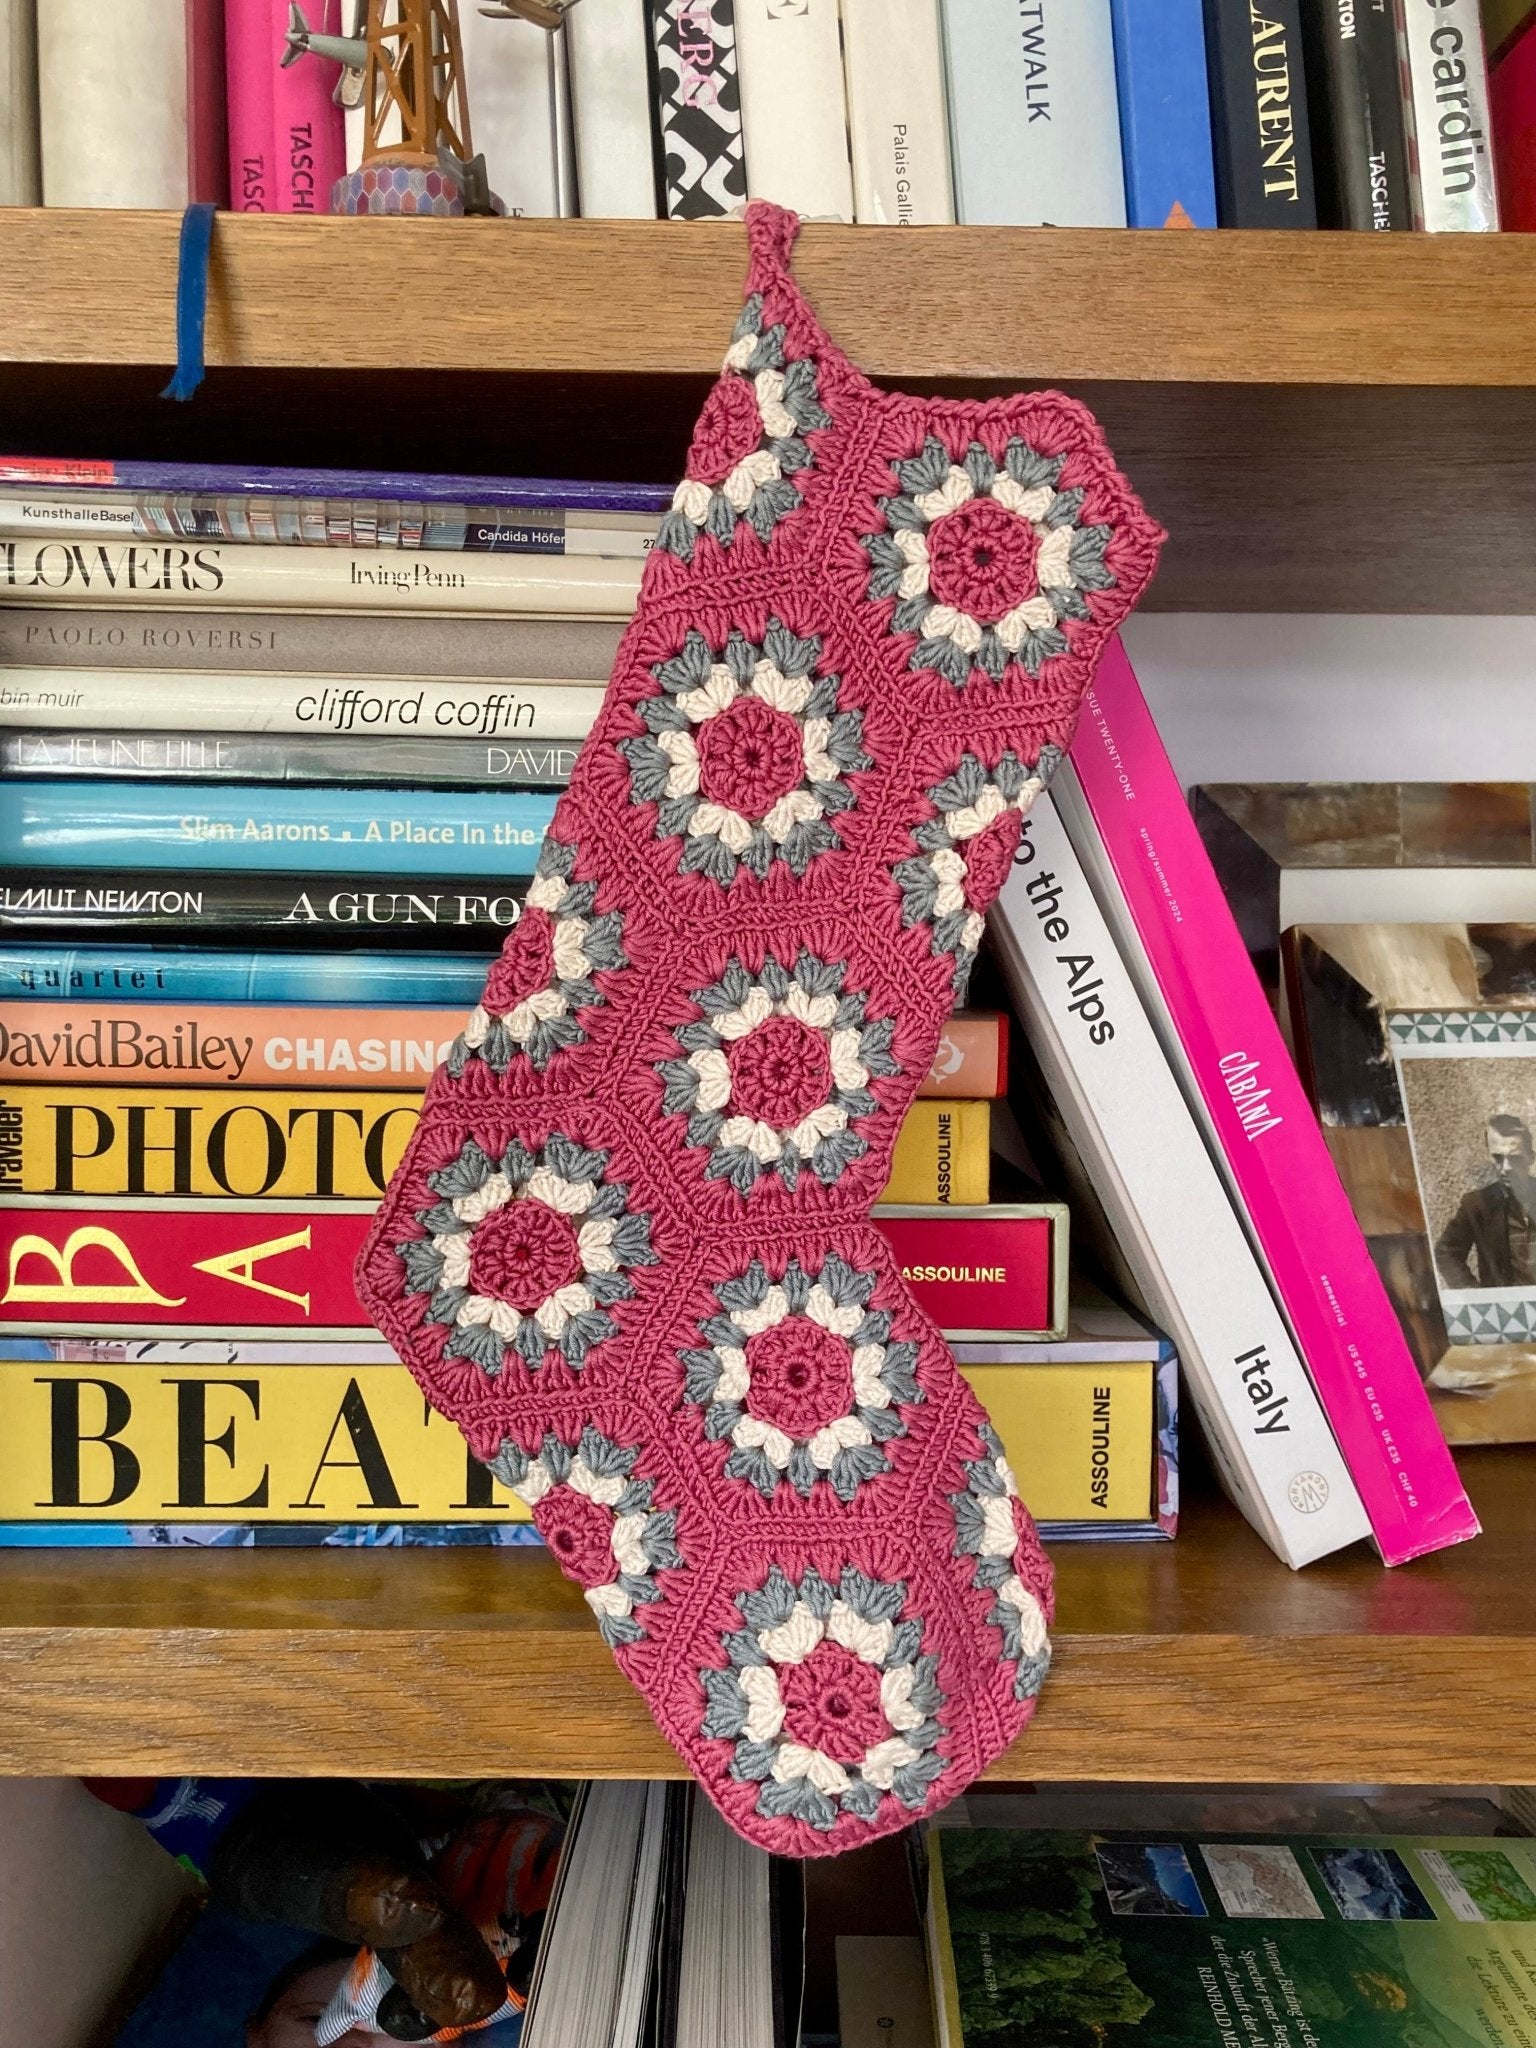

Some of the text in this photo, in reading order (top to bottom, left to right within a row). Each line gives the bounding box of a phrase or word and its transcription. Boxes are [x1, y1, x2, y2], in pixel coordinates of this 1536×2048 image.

[1429, 26, 1484, 196] cardin
[290, 122, 314, 213] TASCH
[893, 124, 909, 175] Palais
[1369, 151, 1391, 232] TASCHE
[478, 529, 528, 542] Candida
[0, 542, 223, 591] LOWERS
[351, 561, 465, 593] Irving Penn
[25, 626, 276, 650] PAOLO ROVERSI
[37, 689, 84, 707] muir
[295, 688, 536, 734] clifford coffin
[18, 738, 233, 769] LA JEUNE FILLE
[487, 747, 578, 776] DAVID
[1097, 717, 1136, 801] TWENTY-ONE
[242, 819, 329, 842] Aarons
[364, 820, 383, 841] A
[390, 820, 454, 844] Place
[463, 823, 485, 843] In
[493, 822, 535, 845] the
[1140, 826, 1184, 923] spring/summer 2024
[85, 889, 203, 913] NEWTON
[282, 892, 528, 926] A GUN FO
[20, 968, 166, 990] quartet
[1025, 870, 1070, 943] the
[1055, 955, 1115, 1046] Alps
[1218, 1051, 1284, 1142] CABANA
[937, 1113, 951, 1204] ASSOULINE
[902, 1266, 1006, 1282] ASSOULINE
[1320, 1274, 1348, 1328] semestrial
[1233, 1344, 1291, 1434] Italy
[1090, 1386, 1111, 1509] ASSOULINE
[1364, 1386, 1376, 1401] EU
[1381, 1428, 1394, 1445] UK
[1398, 1471, 1414, 1493] CHF
[1407, 1493, 1418, 1508] 40
[1197, 1966, 1232, 2027] REINHOLD
[1210, 1935, 1270, 2048] der die Zukunft der Al
[1238, 1950, 1267, 1993] Sprecher
[1255, 1995, 1279, 2021] jener
[1295, 2019, 1311, 2032] ist
[1303, 2034, 1321, 2048] de
